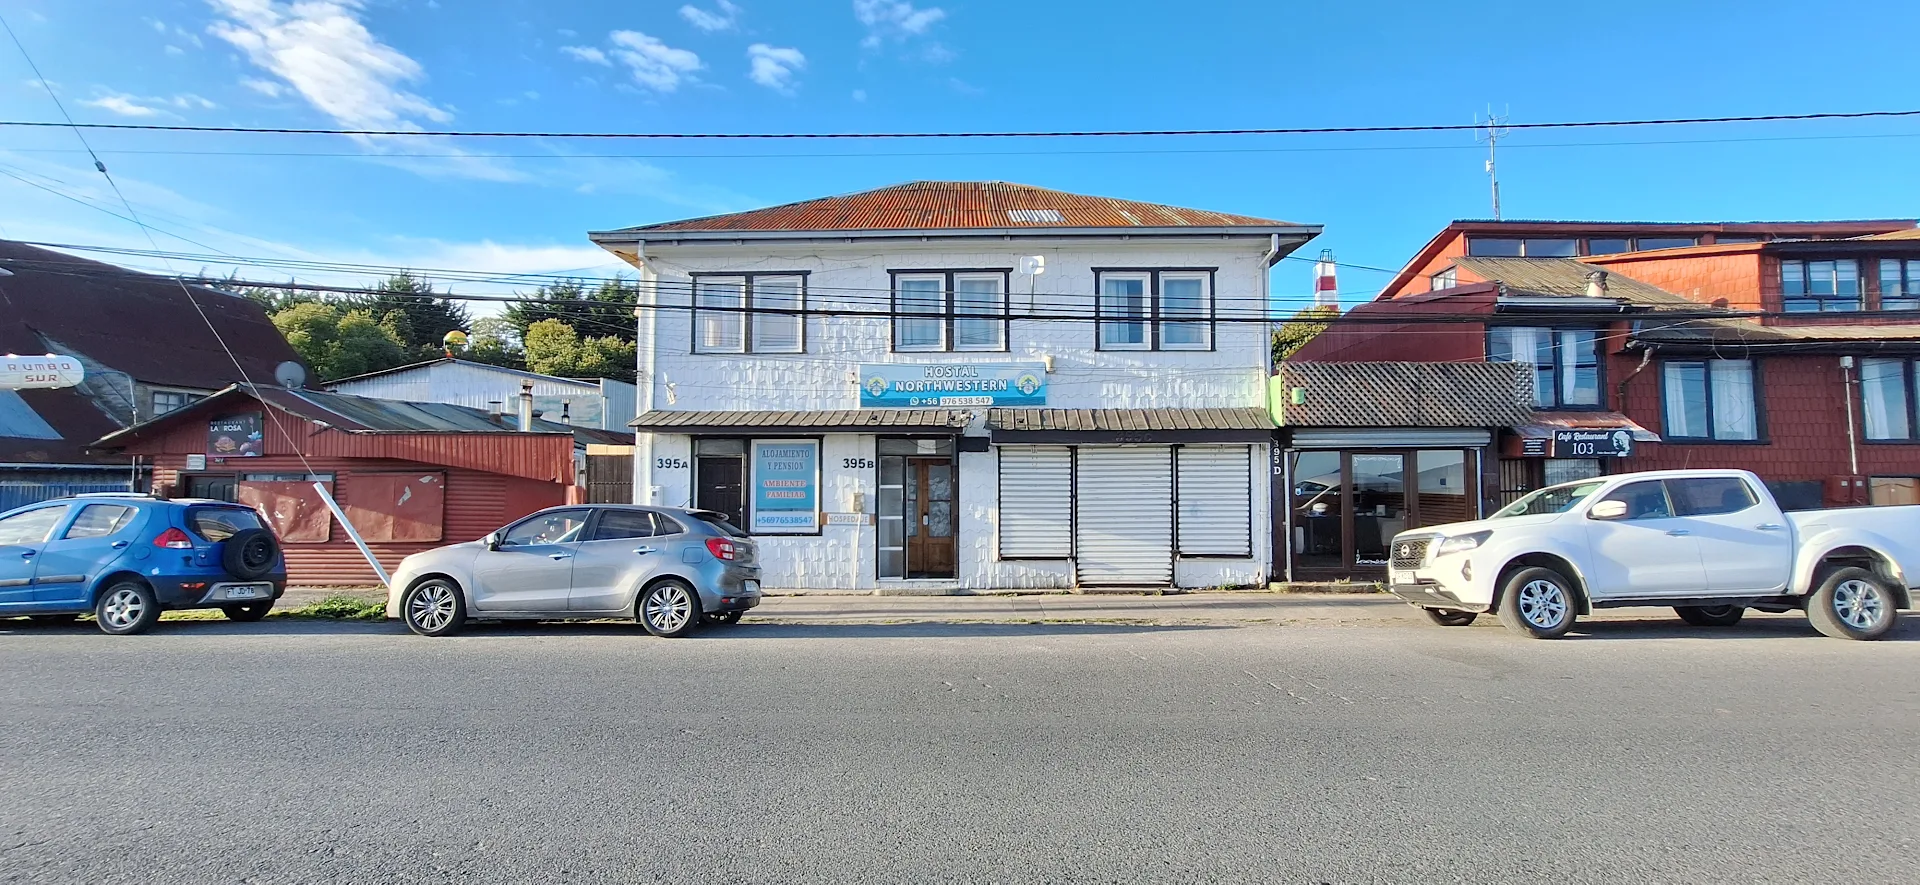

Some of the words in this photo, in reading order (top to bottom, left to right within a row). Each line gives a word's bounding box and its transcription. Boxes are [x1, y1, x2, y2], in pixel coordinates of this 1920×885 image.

[6, 363, 71, 371] RUMBO
[924, 366, 979, 377] HOSTAL
[895, 379, 1008, 392] NORTHWESTERN
[921, 397, 938, 405] +56
[941, 397, 957, 405] 976
[958, 397, 973, 405] 538
[975, 396, 990, 405] 547
[1558, 432, 1572, 442] Café
[1573, 432, 1609, 441] Restaurant
[762, 449, 810, 458] ALOJAMIENTO
[1572, 442, 1594, 455] 103
[657, 458, 688, 469] 395A
[767, 462, 772, 470] Y
[774, 461, 804, 470] PENSION
[843, 458, 874, 469] 395B
[757, 516, 813, 524] +56976538547
